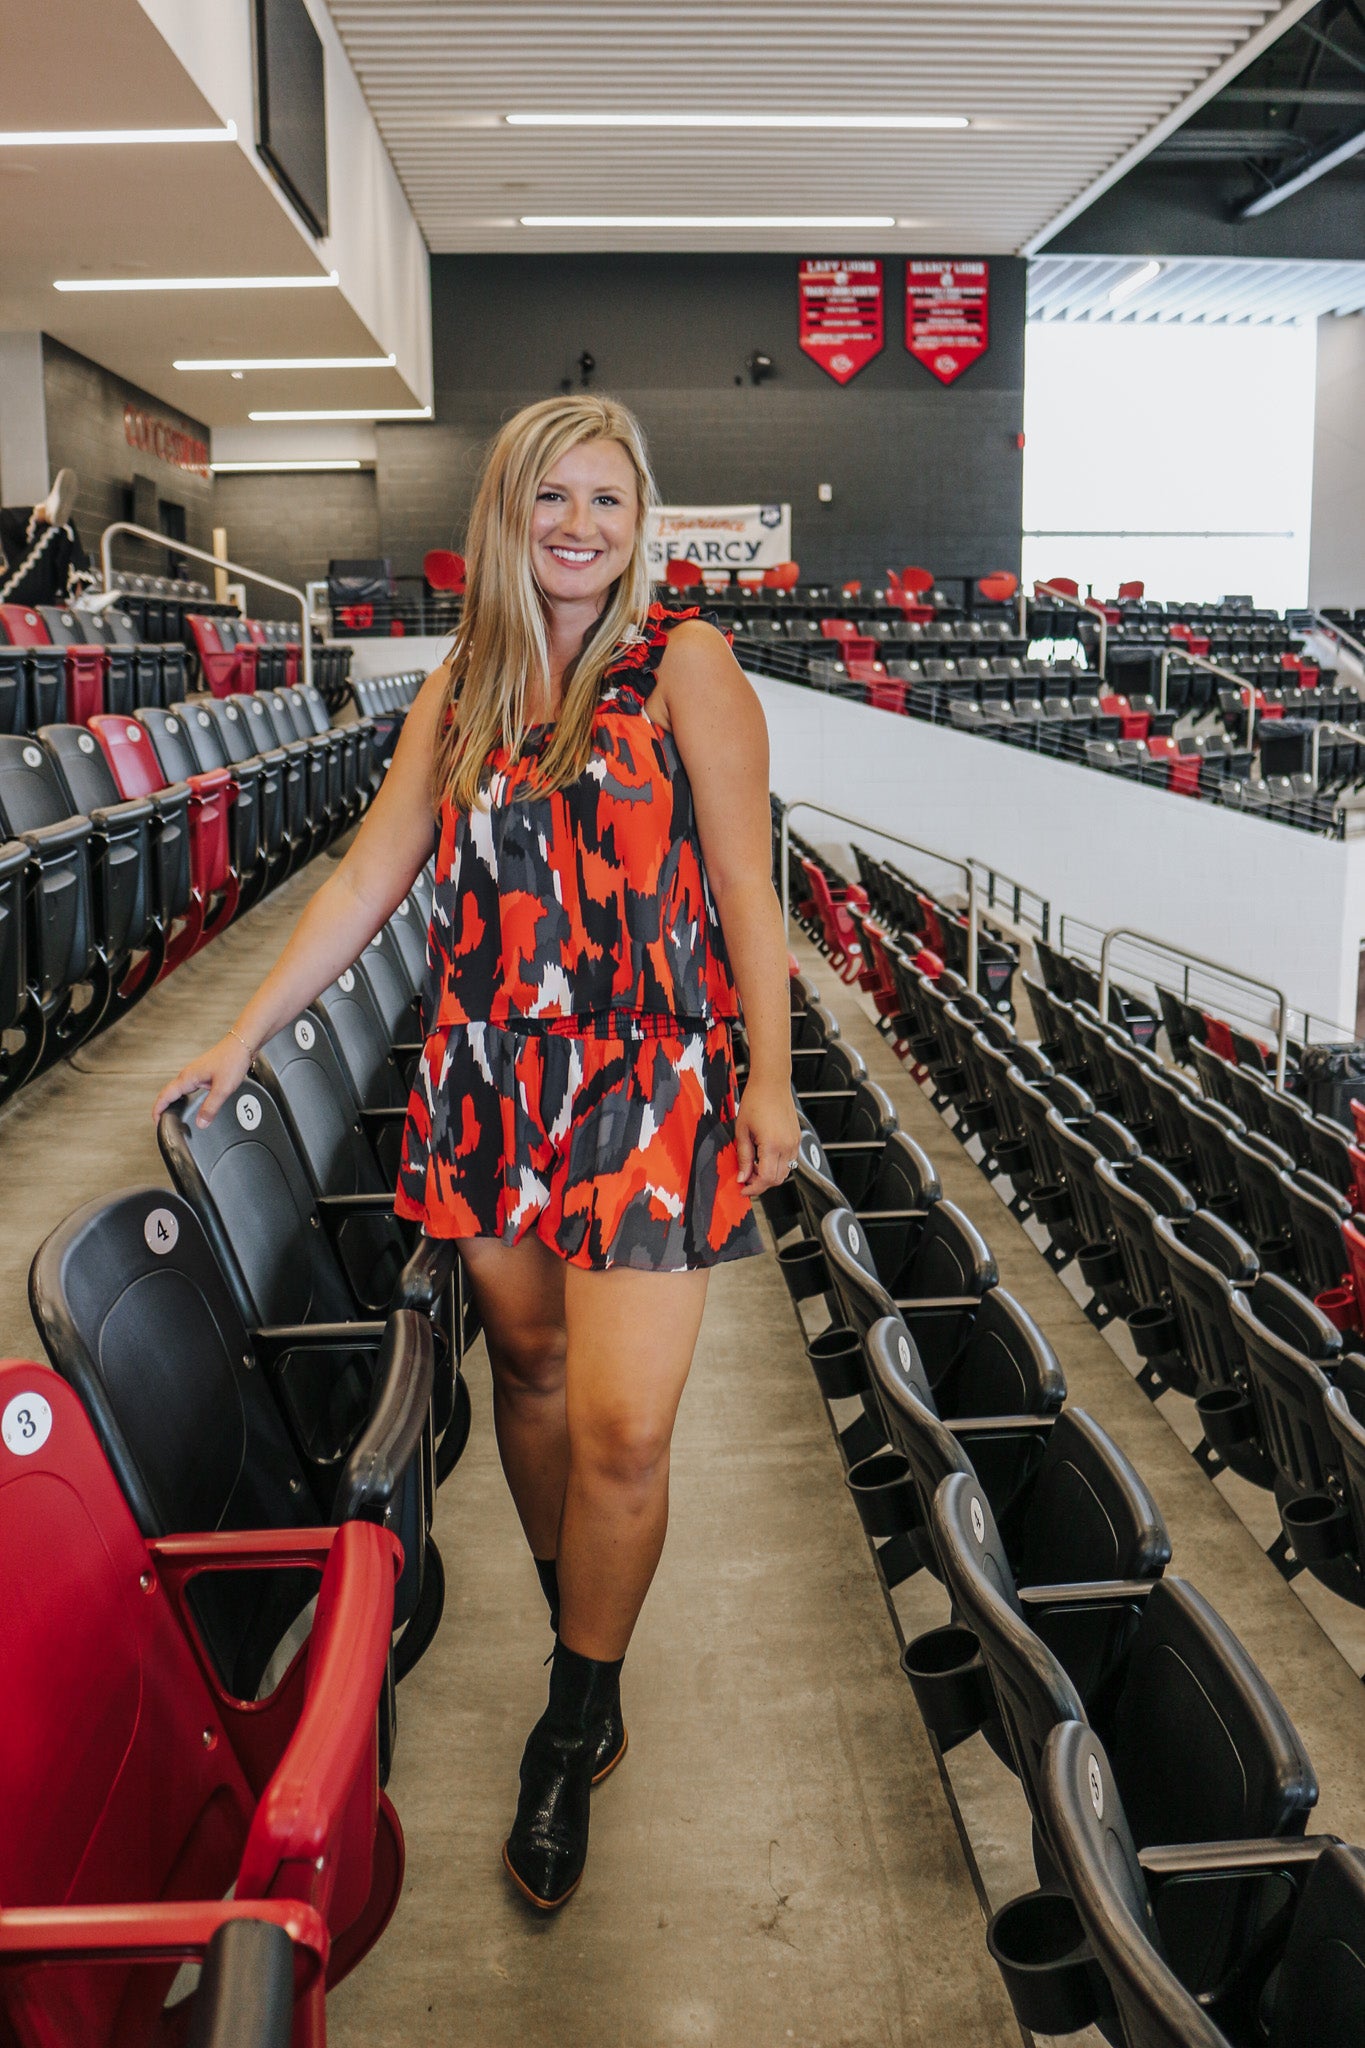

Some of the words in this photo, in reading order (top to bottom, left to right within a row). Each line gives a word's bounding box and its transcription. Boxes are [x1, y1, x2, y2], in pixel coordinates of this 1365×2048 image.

[647, 541, 763, 562] SEARCY
[300, 1027, 309, 1042] 6
[242, 1103, 254, 1122] 5
[155, 1220, 170, 1242] 4
[17, 1409, 37, 1438] 3
